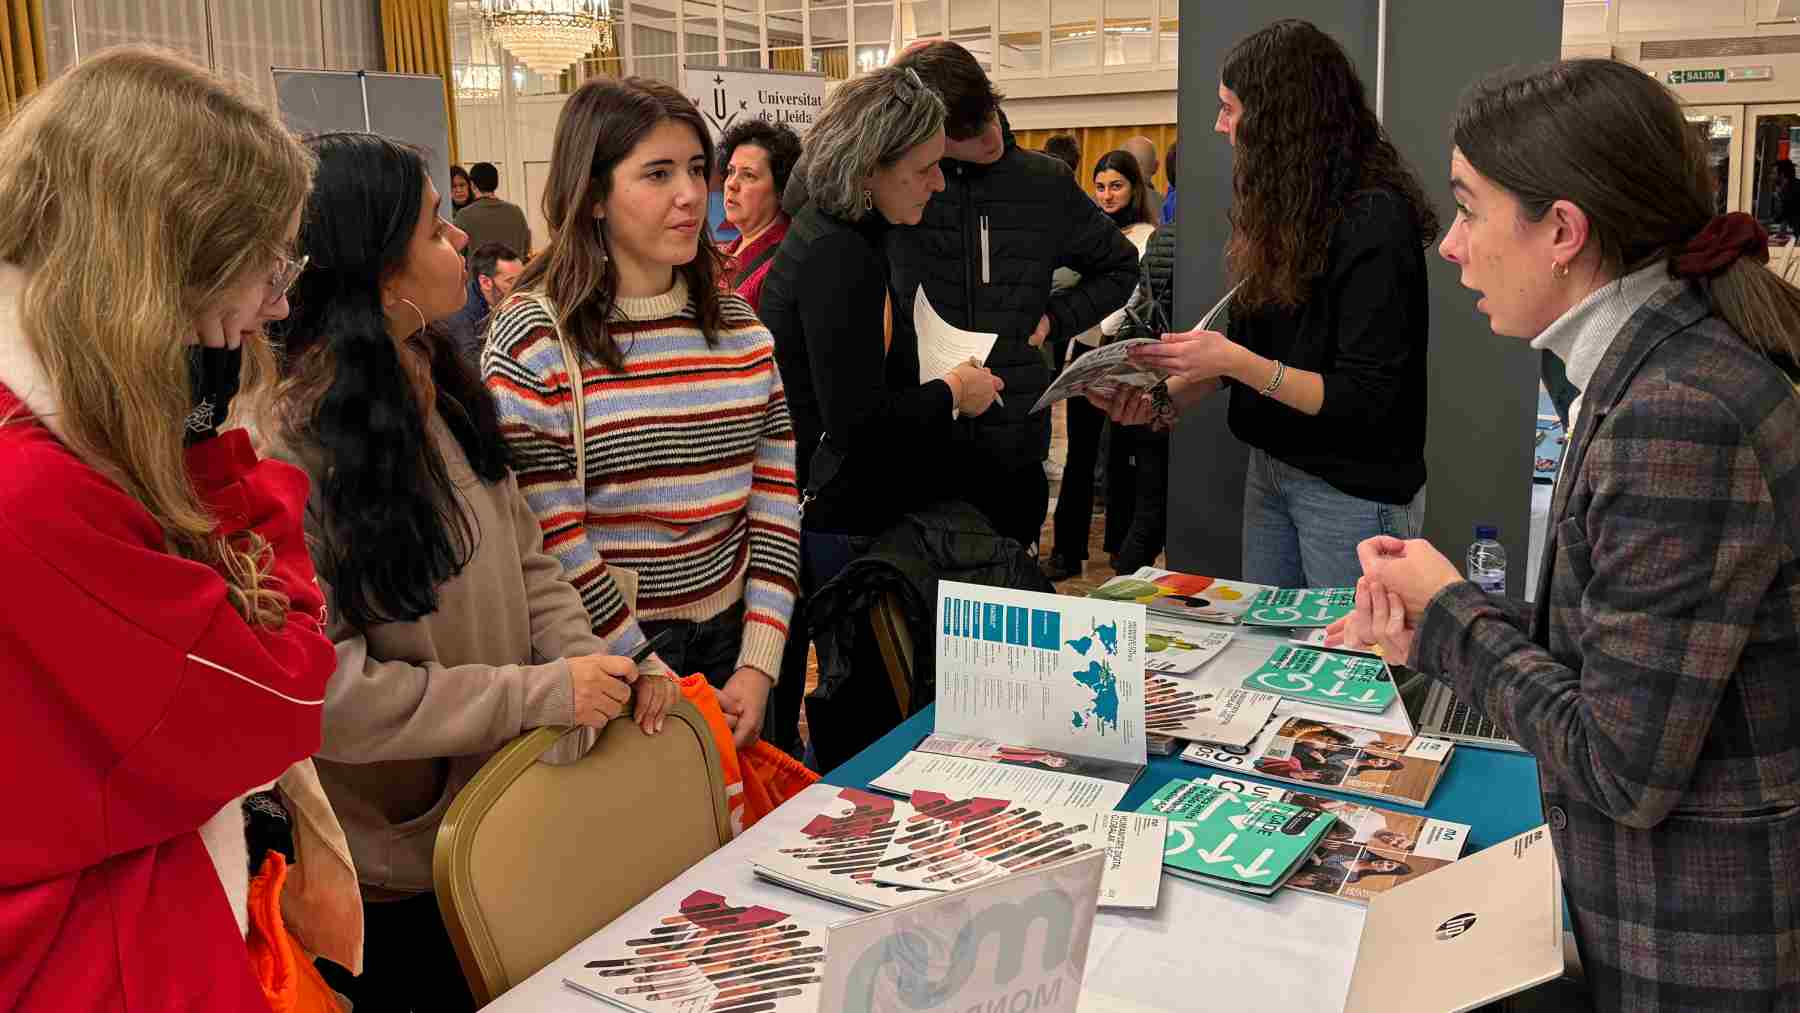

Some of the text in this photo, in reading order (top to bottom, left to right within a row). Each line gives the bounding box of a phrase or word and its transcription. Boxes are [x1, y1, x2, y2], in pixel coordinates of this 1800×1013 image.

[1686, 72, 1721, 81] SALIDA
[758, 90, 822, 107] Universitat
[759, 110, 812, 123] de Lleida
